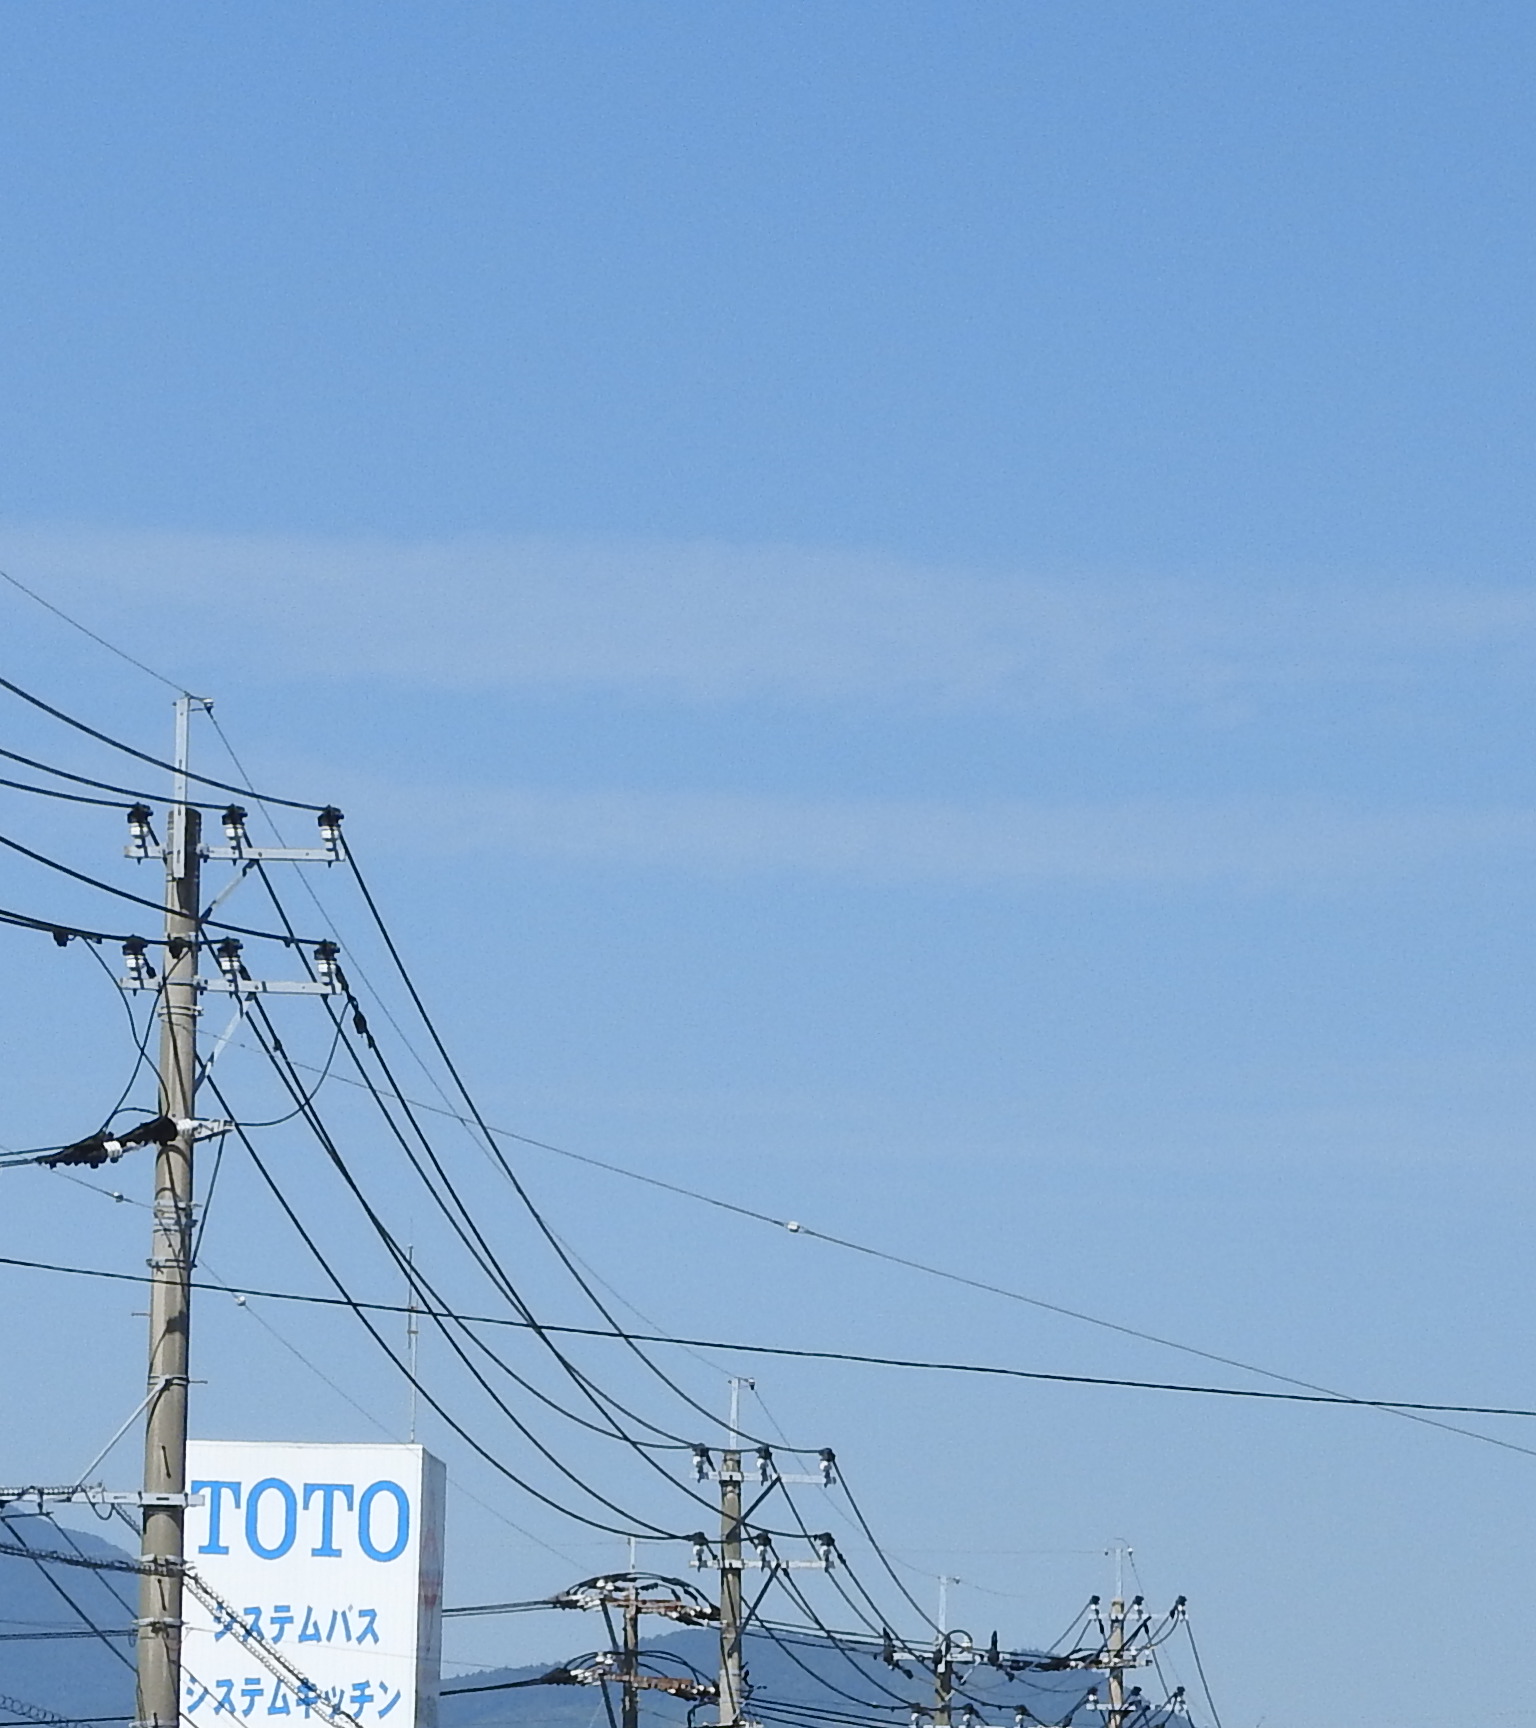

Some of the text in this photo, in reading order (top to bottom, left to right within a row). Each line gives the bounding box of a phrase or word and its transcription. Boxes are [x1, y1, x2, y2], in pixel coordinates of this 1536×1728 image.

[191, 1478, 411, 1562] TOTO
[213, 1604, 380, 1645] システムバス
[185, 1677, 402, 1720] システムキッチン
